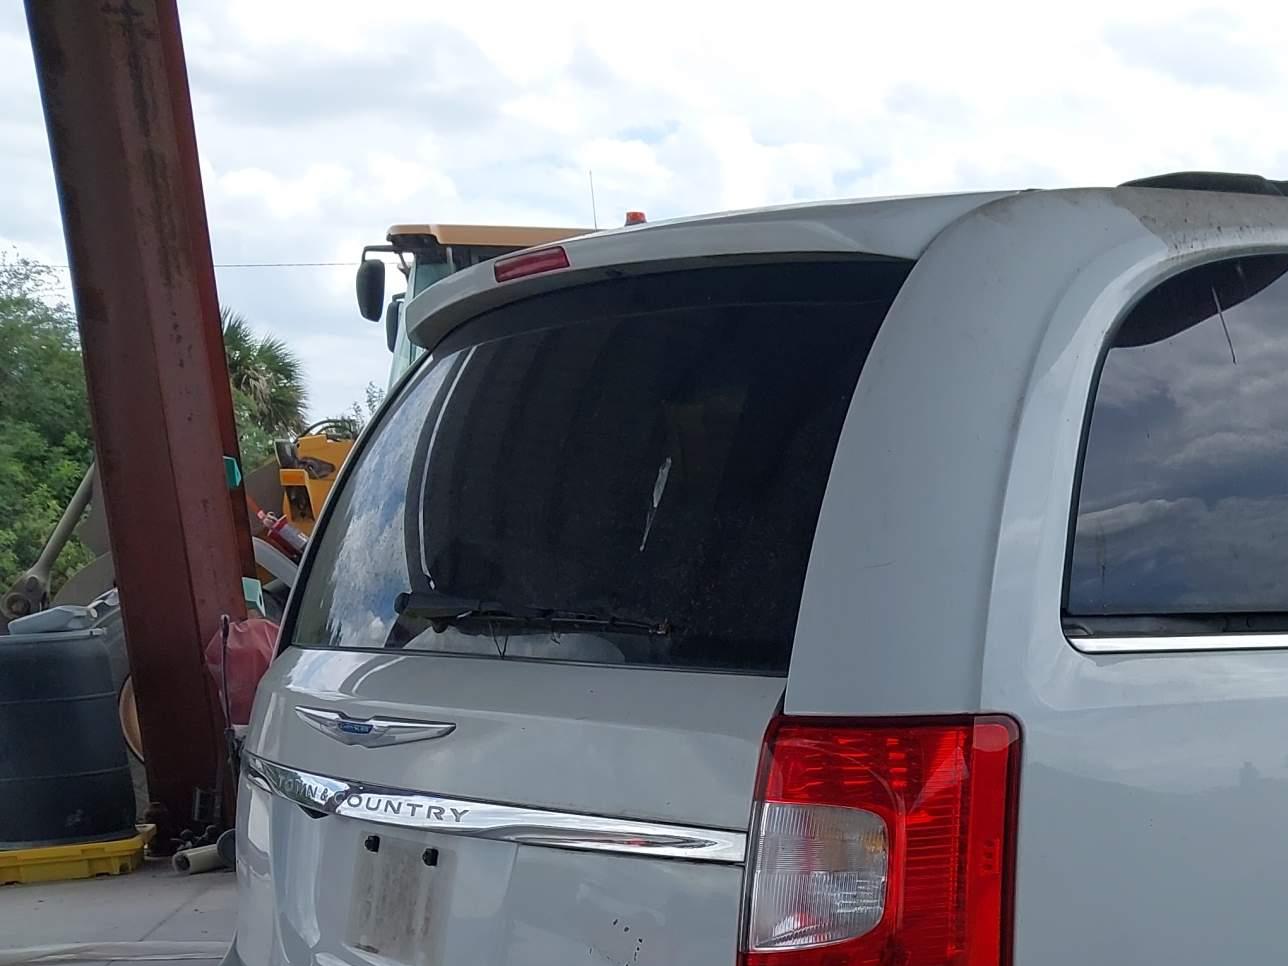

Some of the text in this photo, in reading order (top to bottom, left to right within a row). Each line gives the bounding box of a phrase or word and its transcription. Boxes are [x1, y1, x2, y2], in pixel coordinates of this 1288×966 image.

[279, 775, 469, 823] TOWN & COUNTRY
